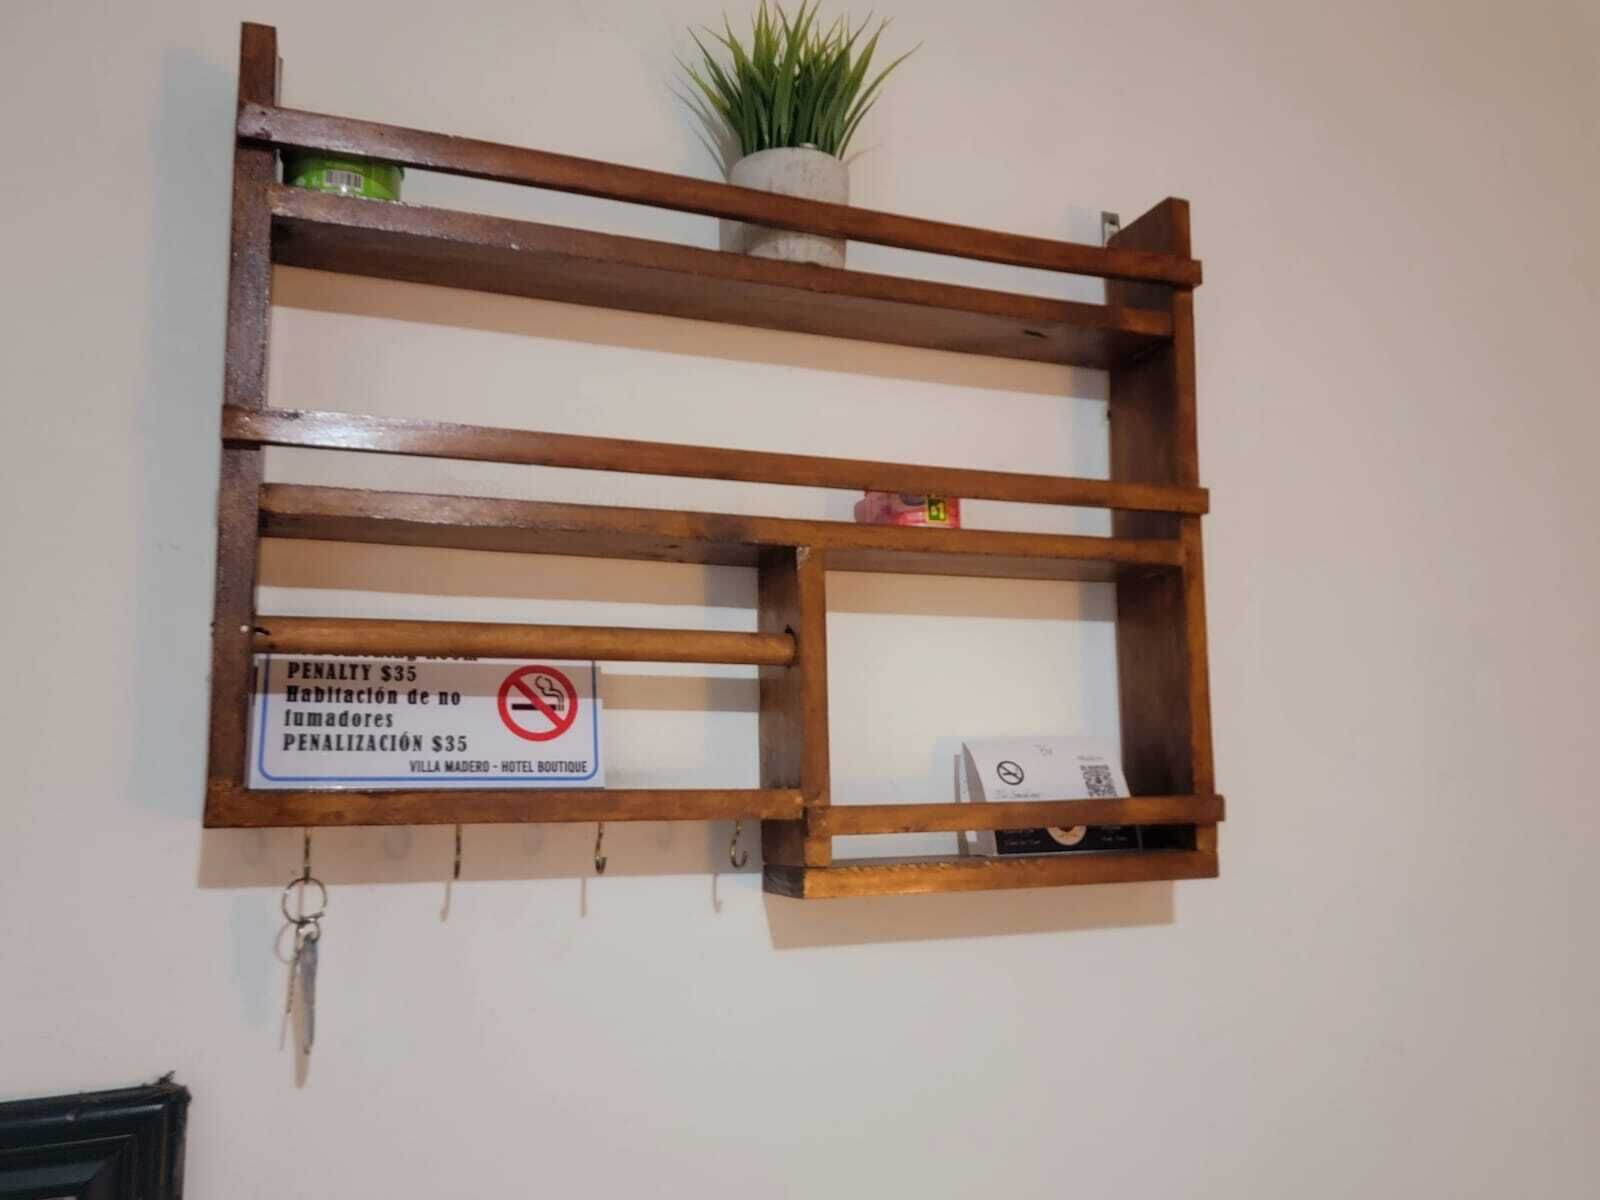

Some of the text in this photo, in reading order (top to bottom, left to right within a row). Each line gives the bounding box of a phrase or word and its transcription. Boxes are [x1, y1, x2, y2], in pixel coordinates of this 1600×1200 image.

[287, 661, 417, 682] PENALTY $35
[286, 685, 462, 706] Habitación de no
[283, 708, 393, 728] fumadores
[282, 731, 468, 753] PENALIZACIÓN $35
[409, 760, 441, 773] VILLA
[444, 760, 490, 773] MADERO
[501, 760, 535, 773] HOTEL
[537, 760, 588, 773] BOUTIQUE
